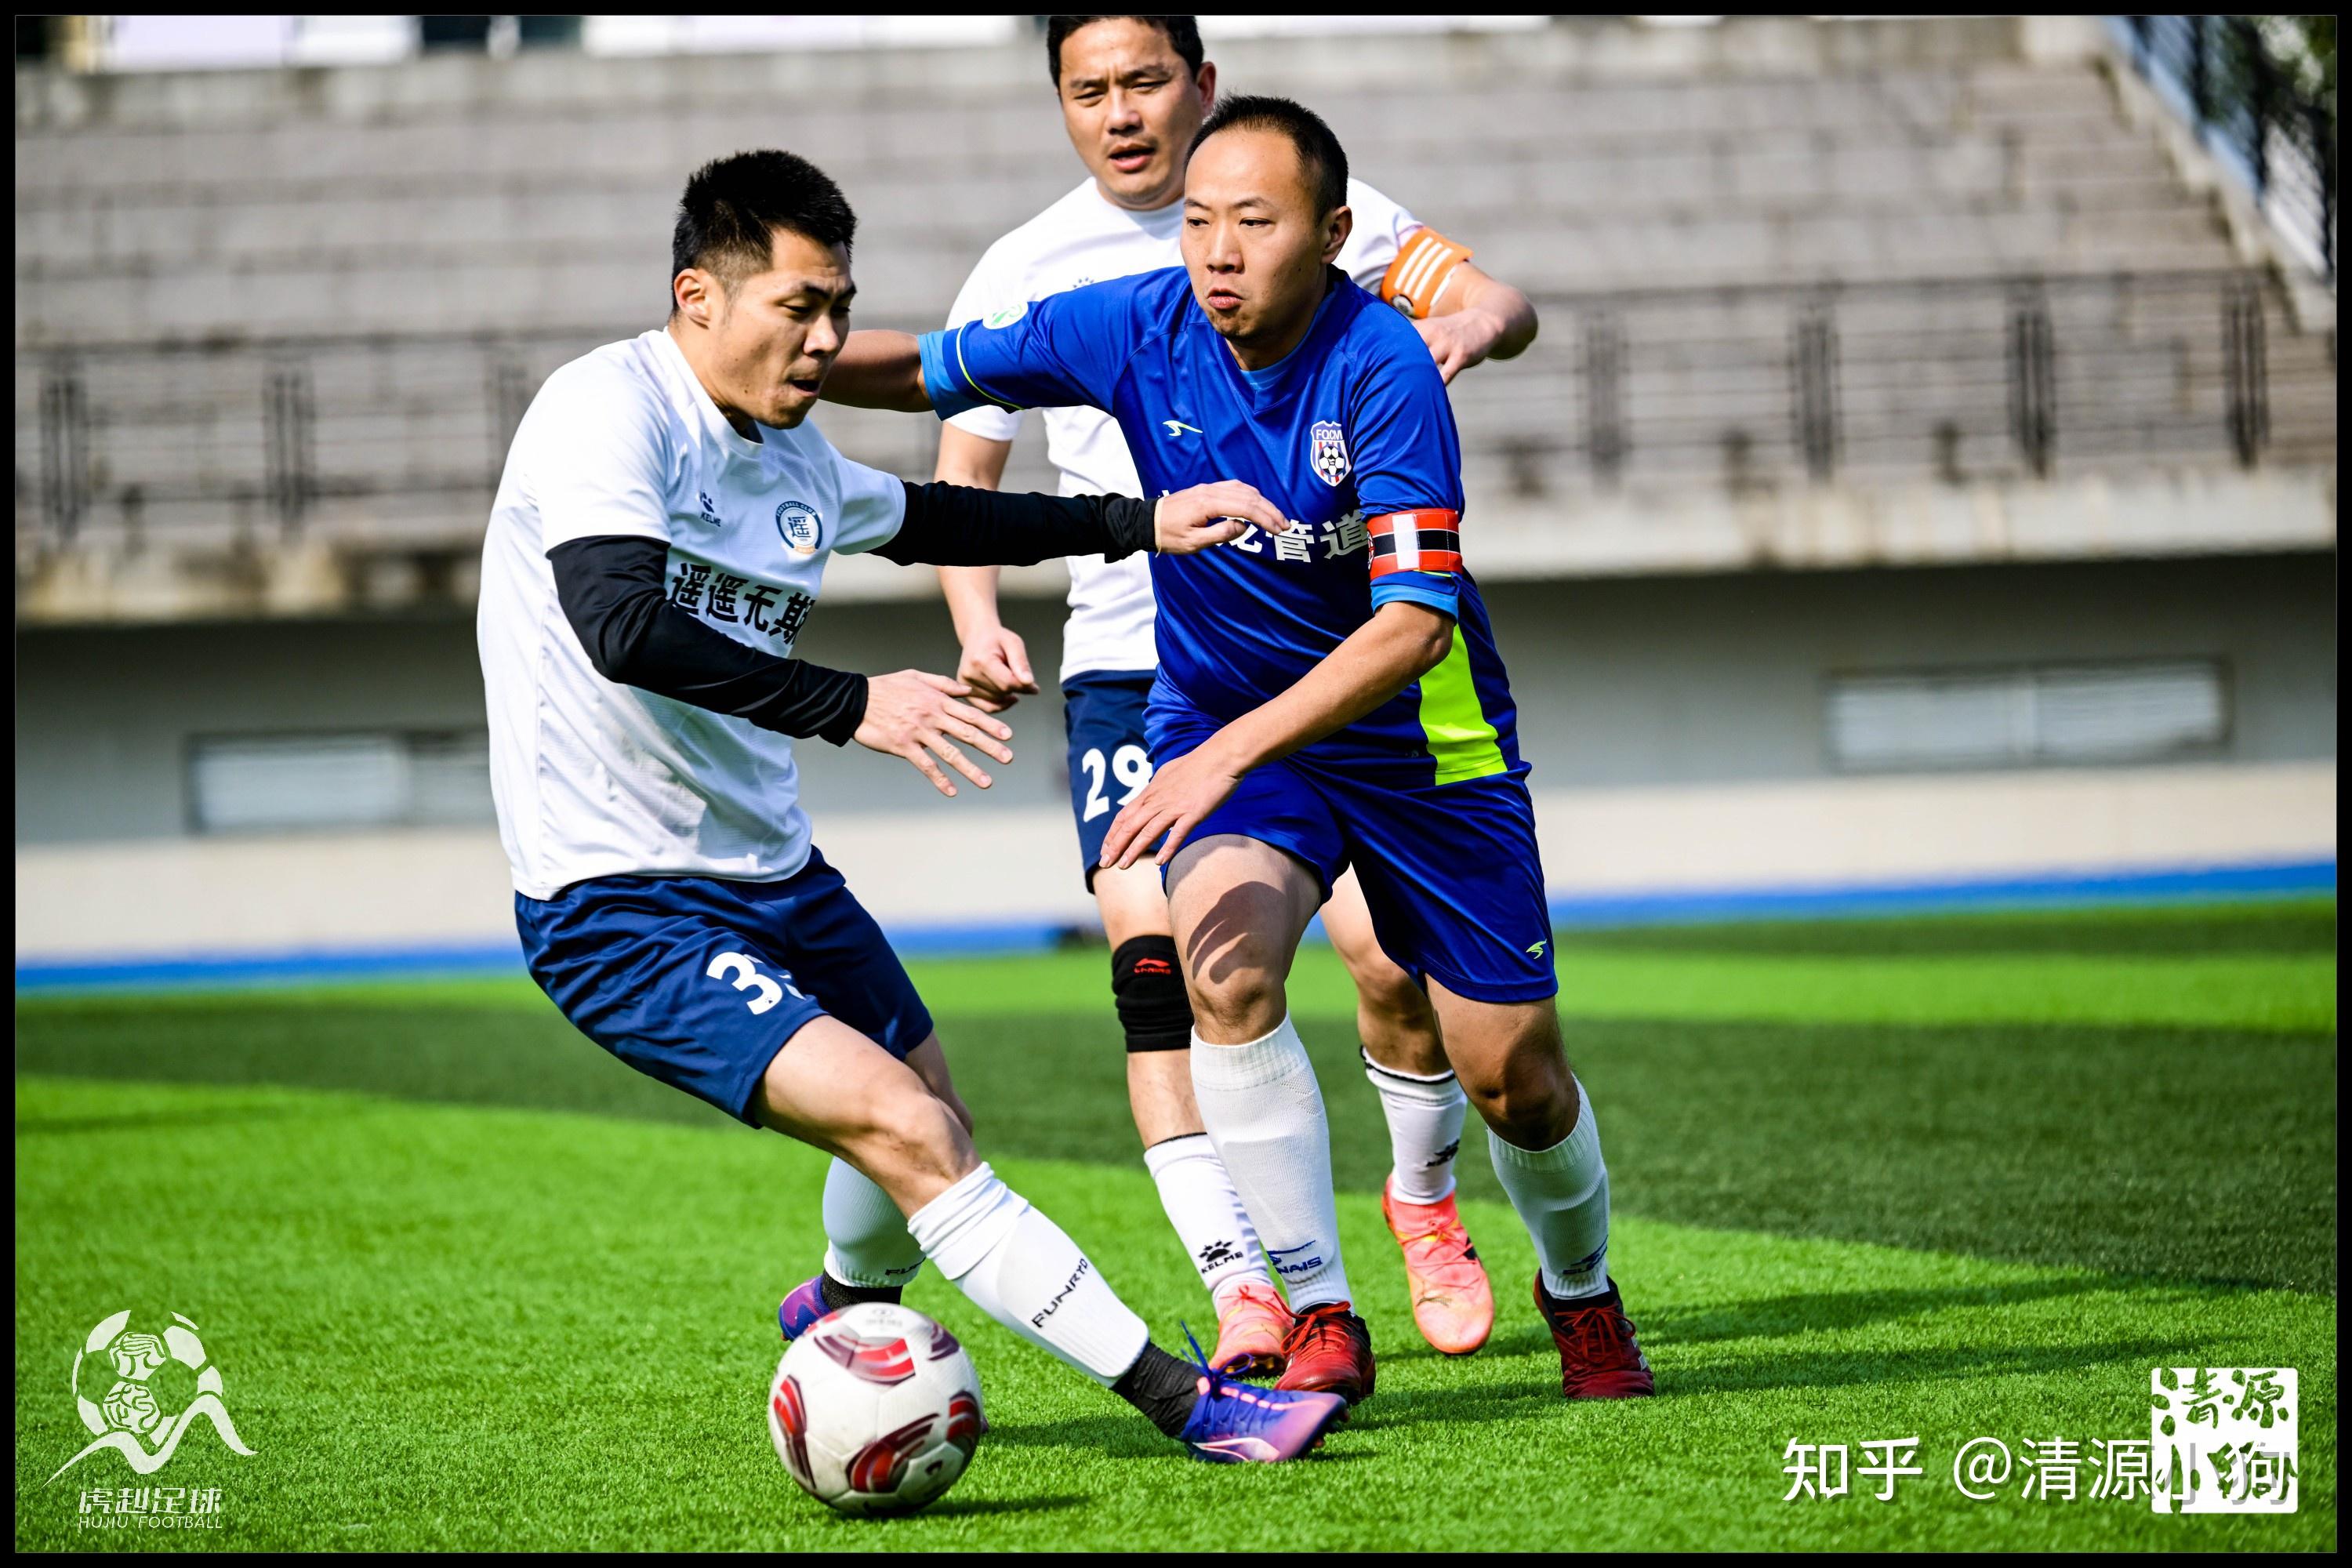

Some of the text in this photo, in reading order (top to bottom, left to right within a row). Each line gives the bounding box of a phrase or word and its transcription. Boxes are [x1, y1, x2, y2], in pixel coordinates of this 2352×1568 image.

[700, 511, 721, 527] KELME
[787, 516, 811, 538] 遥
[666, 562, 816, 645] 遥遥无期
[1082, 744, 1153, 822] 29
[1201, 1251, 1243, 1274] KELME
